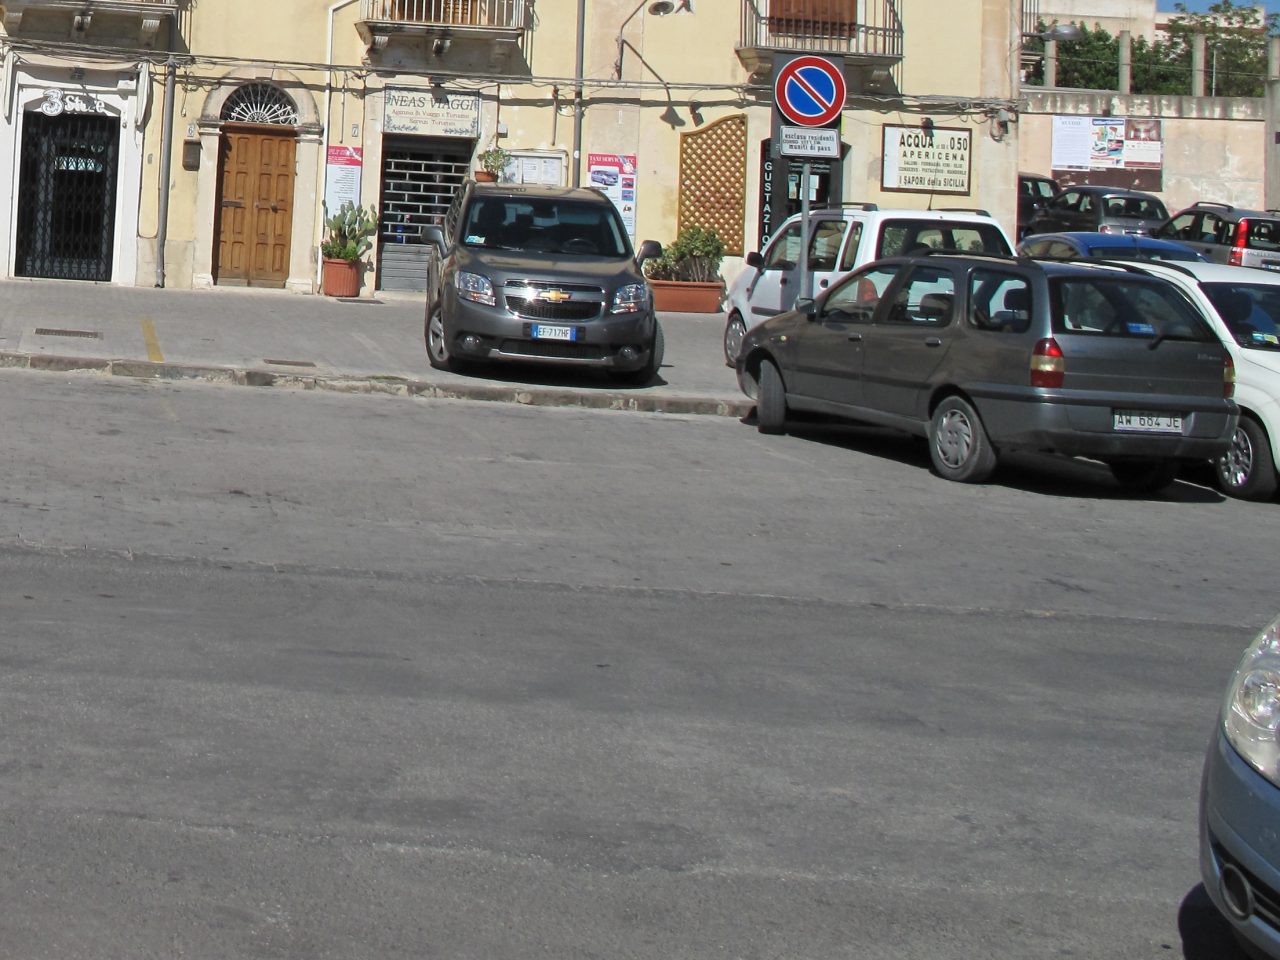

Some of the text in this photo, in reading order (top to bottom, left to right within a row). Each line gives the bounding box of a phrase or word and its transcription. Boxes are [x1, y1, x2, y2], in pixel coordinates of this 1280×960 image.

[40, 88, 65, 117] 3
[430, 97, 475, 111] VIAGGI
[899, 133, 934, 149] ACQUA
[902, 150, 965, 161] APERICENA
[903, 176, 926, 186] SAPORI
[943, 178, 965, 188] SICILIA
[761, 161, 773, 245] GUSTAZIO
[1117, 412, 1180, 429] AW 684 JE
